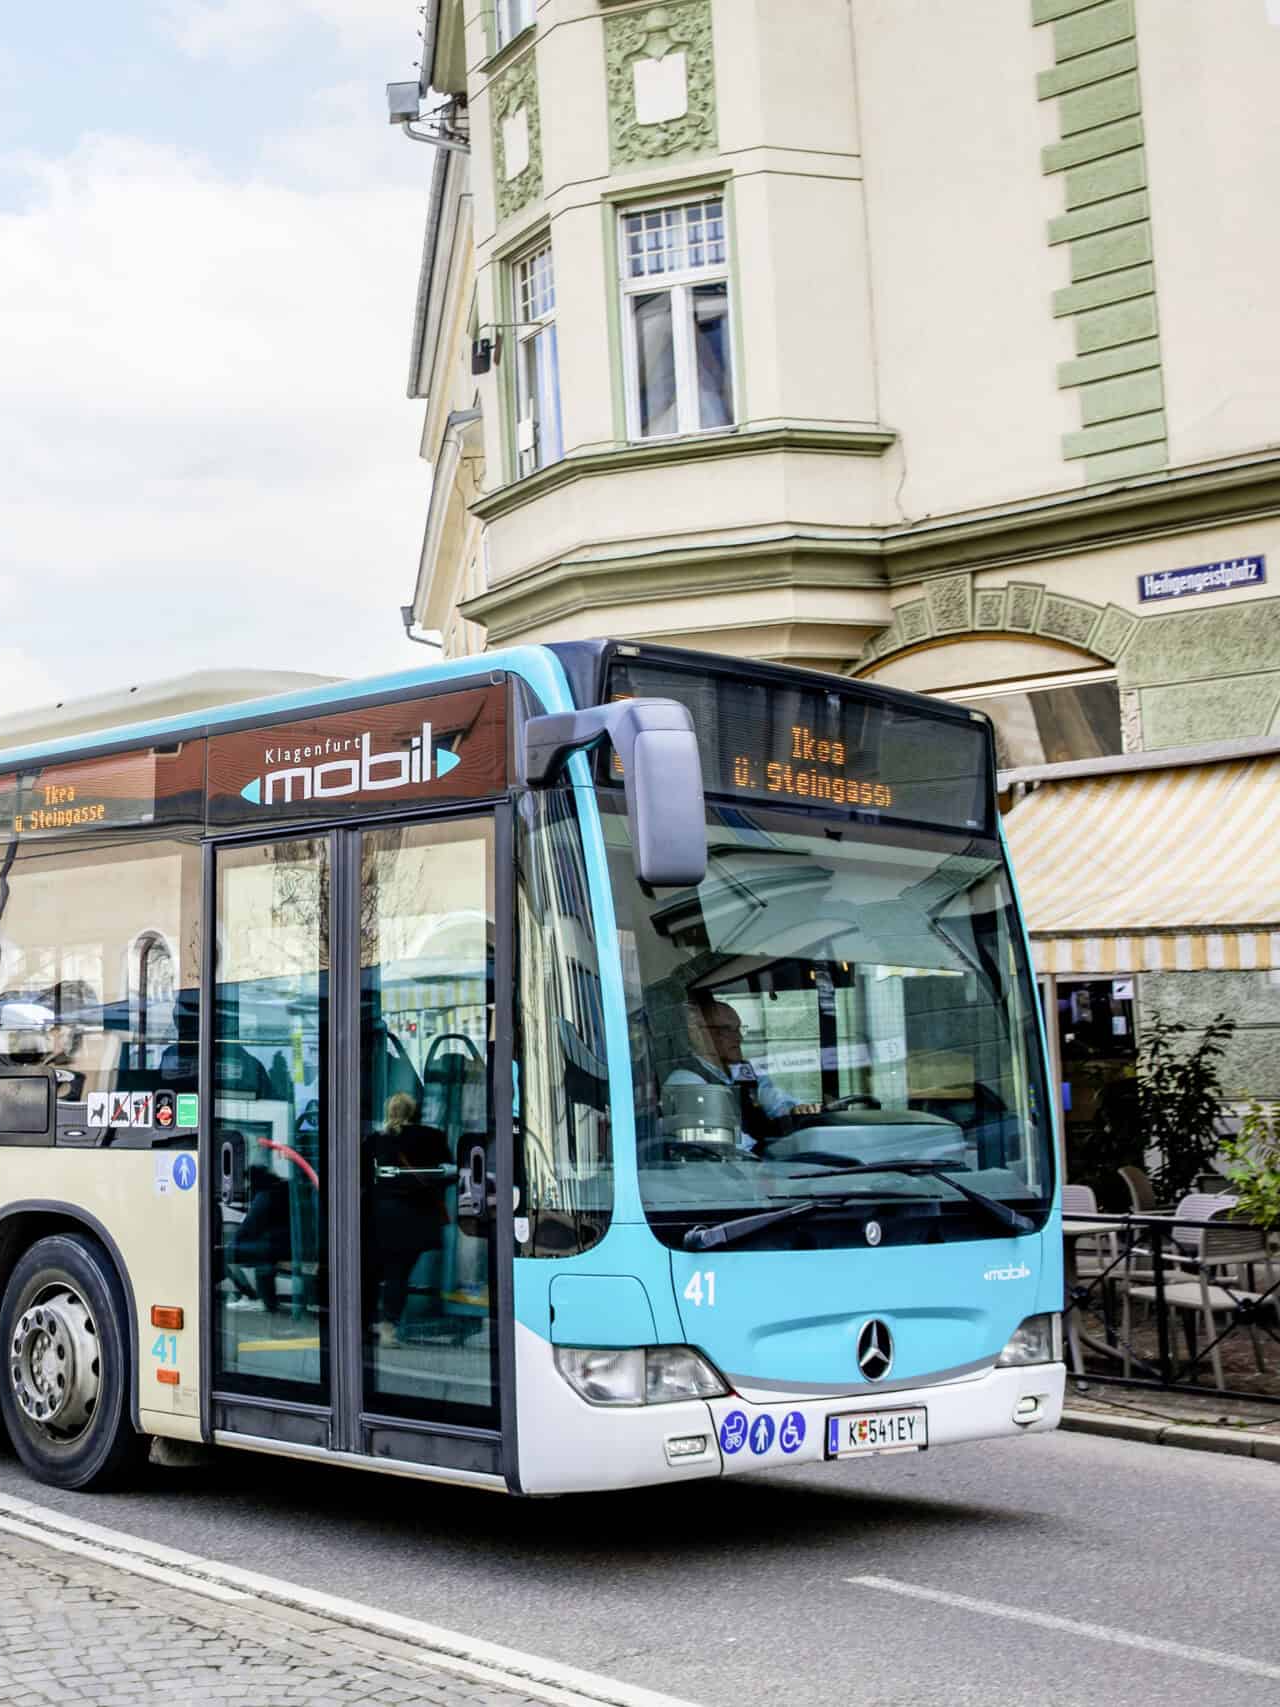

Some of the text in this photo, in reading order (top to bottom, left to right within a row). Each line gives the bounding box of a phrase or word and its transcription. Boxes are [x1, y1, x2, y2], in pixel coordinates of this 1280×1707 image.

[265, 737, 361, 764] Klagenfurt
[791, 727, 846, 765] Ikea
[265, 721, 432, 805] mobil
[45, 785, 75, 806] Ikea
[31, 804, 105, 830] Steingasse
[987, 1261, 1026, 1281] mobil
[684, 1271, 716, 1307] 41
[151, 1333, 177, 1365] 41
